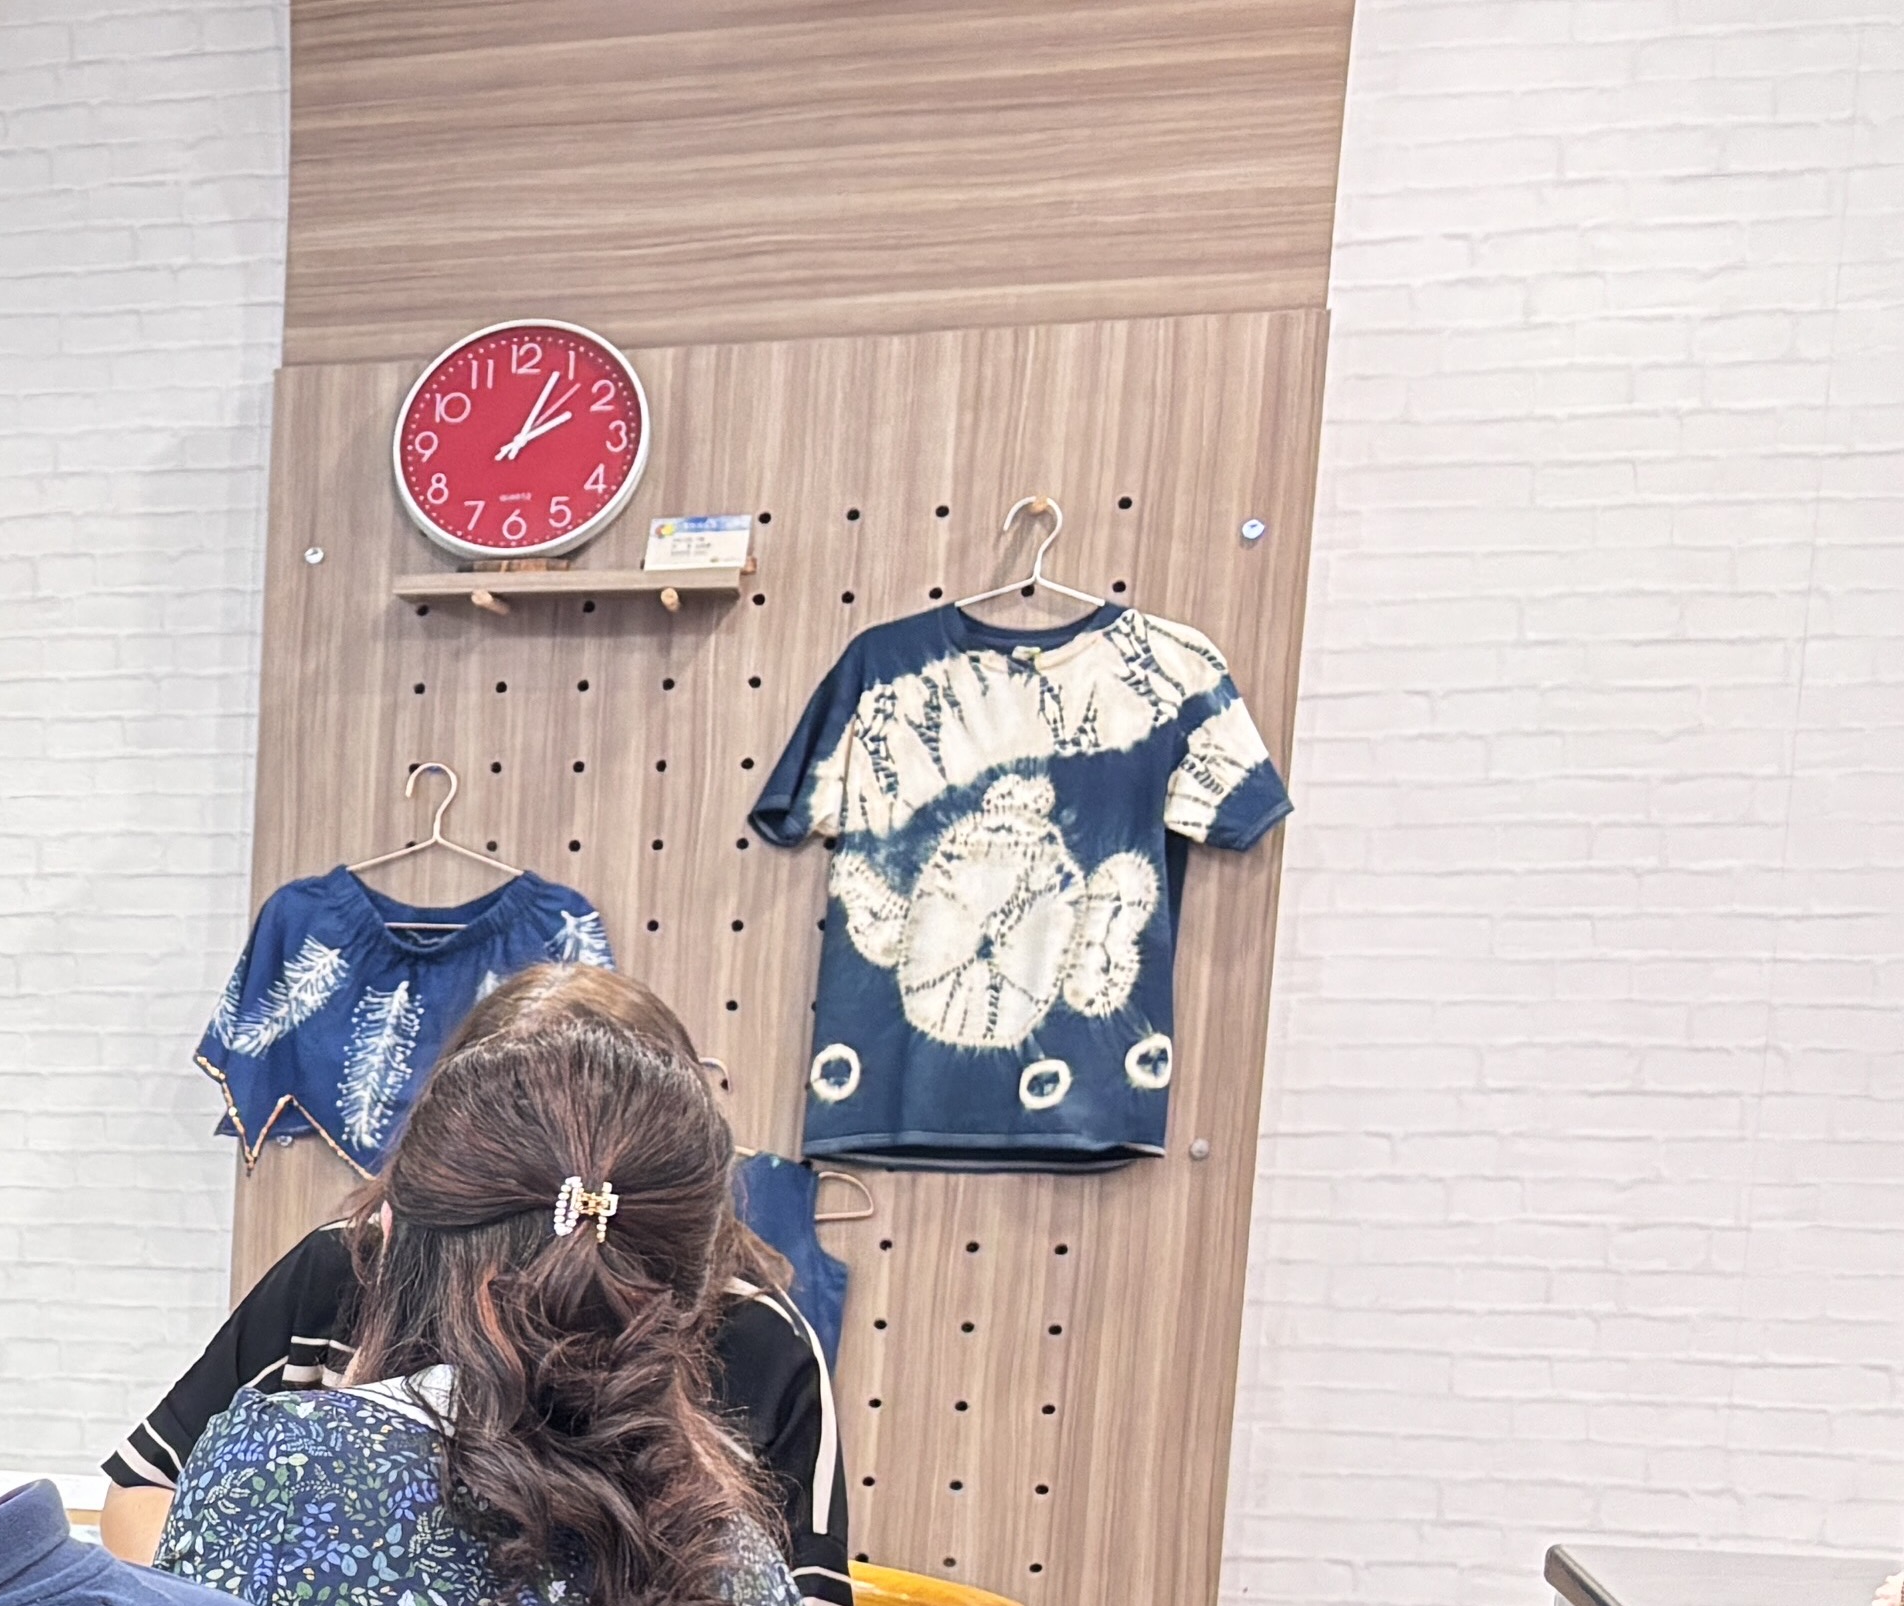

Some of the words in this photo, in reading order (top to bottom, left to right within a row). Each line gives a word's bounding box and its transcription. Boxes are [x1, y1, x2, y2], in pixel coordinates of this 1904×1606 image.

[511, 343, 542, 374] 12
[567, 350, 576, 380] 1
[471, 359, 494, 390] 11
[435, 392, 471, 423] 10
[590, 379, 615, 411] 2
[415, 431, 438, 463] 9
[606, 420, 627, 452] 3
[427, 473, 449, 504] 8
[583, 463, 607, 494] 4
[464, 500, 485, 532] 7
[502, 508, 527, 540] 6
[548, 496, 572, 528] 5
